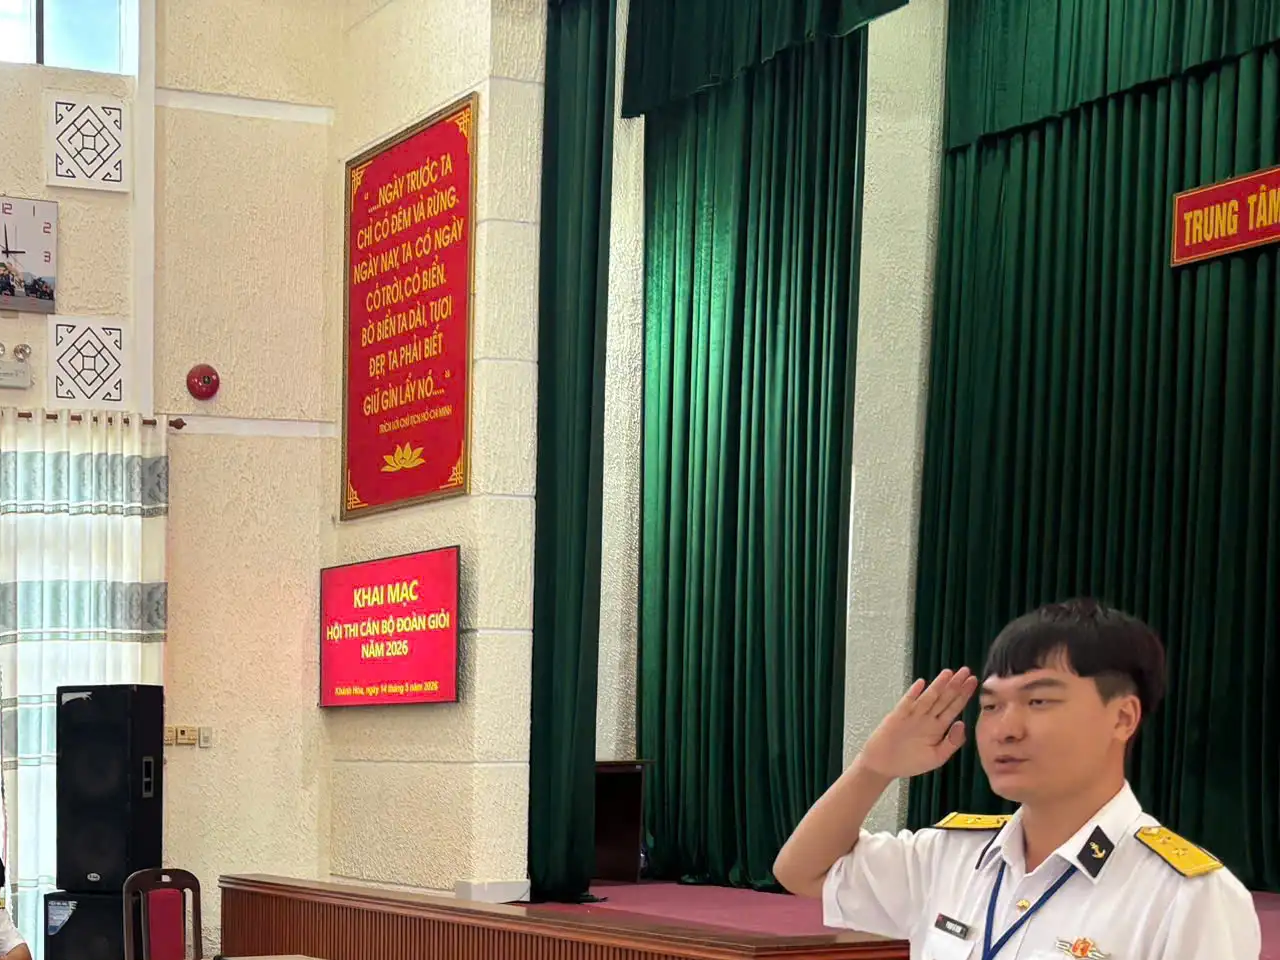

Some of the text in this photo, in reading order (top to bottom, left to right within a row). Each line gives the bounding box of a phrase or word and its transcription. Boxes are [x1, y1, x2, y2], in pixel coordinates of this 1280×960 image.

[406, 156, 438, 194] TRƯỚC
[440, 152, 453, 177] TA
[1, 202, 13, 215] 12
[43, 221, 52, 234] 2
[357, 217, 373, 249] CHỈ
[374, 210, 390, 242] CÓ
[391, 206, 411, 235] ĐÊM
[413, 194, 426, 223] VÀ
[1183, 199, 1239, 246] TRUNG
[44, 251, 52, 263] 3
[353, 253, 379, 285] NGÀY
[402, 241, 412, 264] TA
[415, 227, 431, 258] CÓ
[434, 215, 464, 251] NGÀY
[366, 282, 380, 312] CÓ
[404, 266, 420, 297] CÓ
[361, 319, 375, 347] BỜ
[377, 309, 396, 342] BIỂN
[397, 312, 408, 334] TA
[429, 295, 452, 323] TƯƠI
[388, 349, 399, 371] TA
[400, 334, 422, 367] PHẢI
[424, 324, 443, 359] BIẾT
[363, 387, 380, 416] GIỮ
[381, 382, 398, 411] GÌN
[400, 372, 416, 405] LẤY
[353, 579, 418, 608] KHAI MẠC
[326, 608, 450, 642] HỘI THI CÁN BỘ ĐOÀN GIỎI
[361, 639, 408, 658] NĂM 2026
